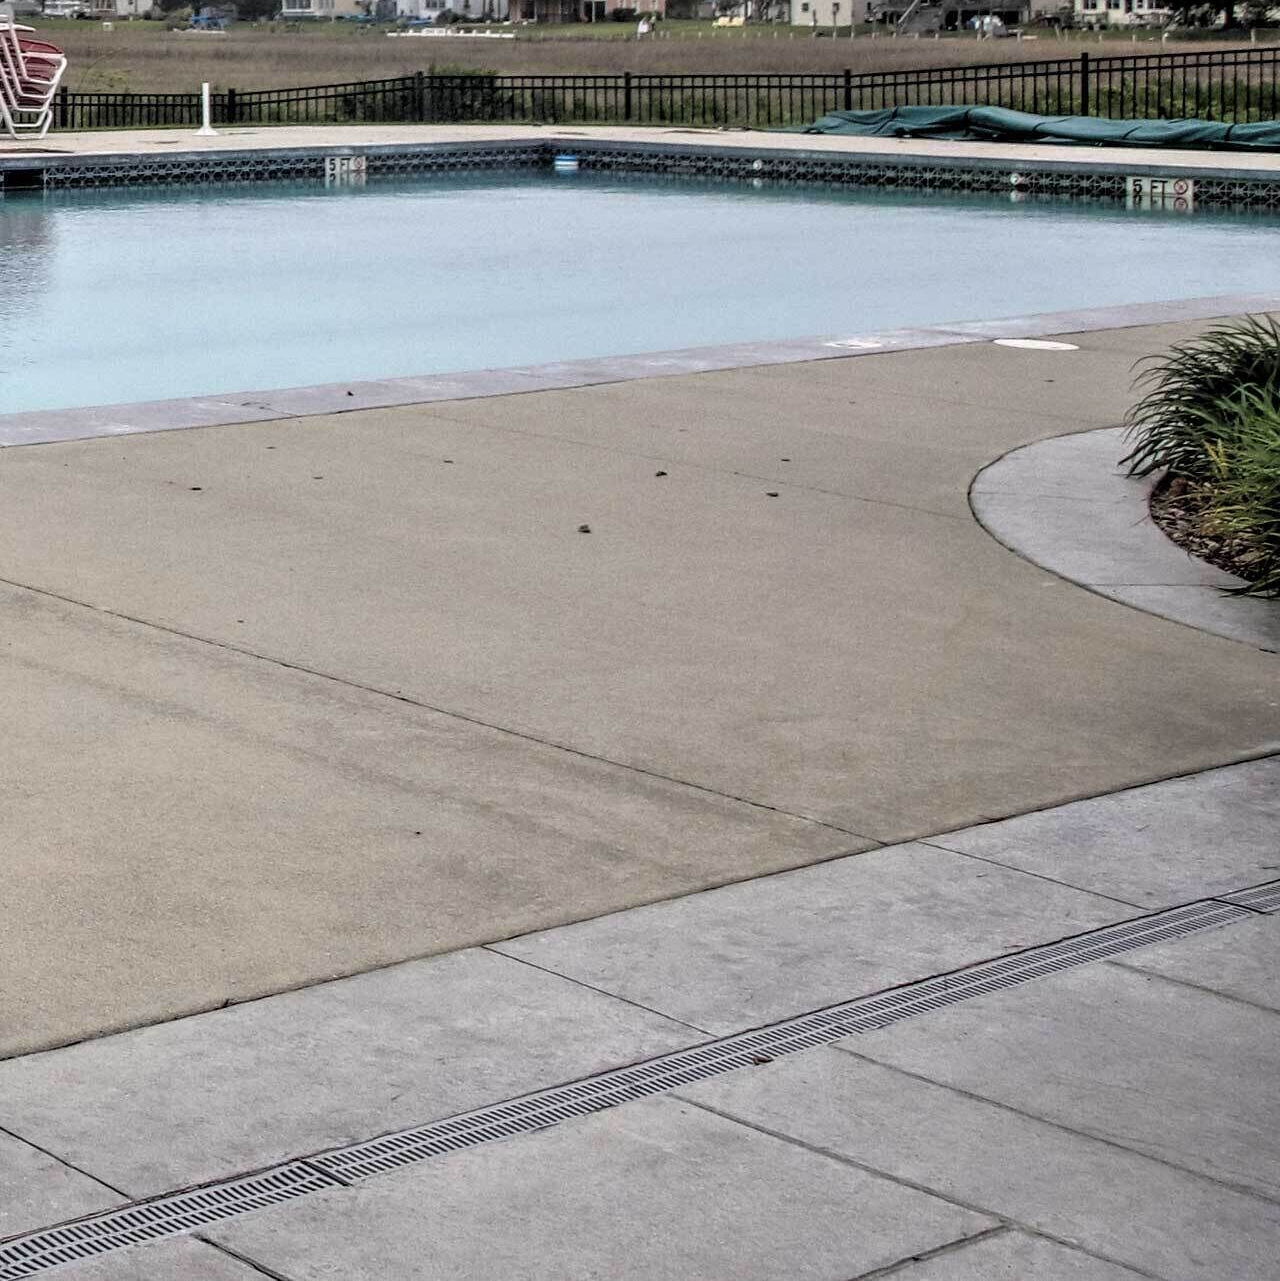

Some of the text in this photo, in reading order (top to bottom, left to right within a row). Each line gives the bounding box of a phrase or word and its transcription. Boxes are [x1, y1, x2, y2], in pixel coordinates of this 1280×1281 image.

[329, 158, 336, 171] 5
[1133, 179, 1168, 195] 5 FT
